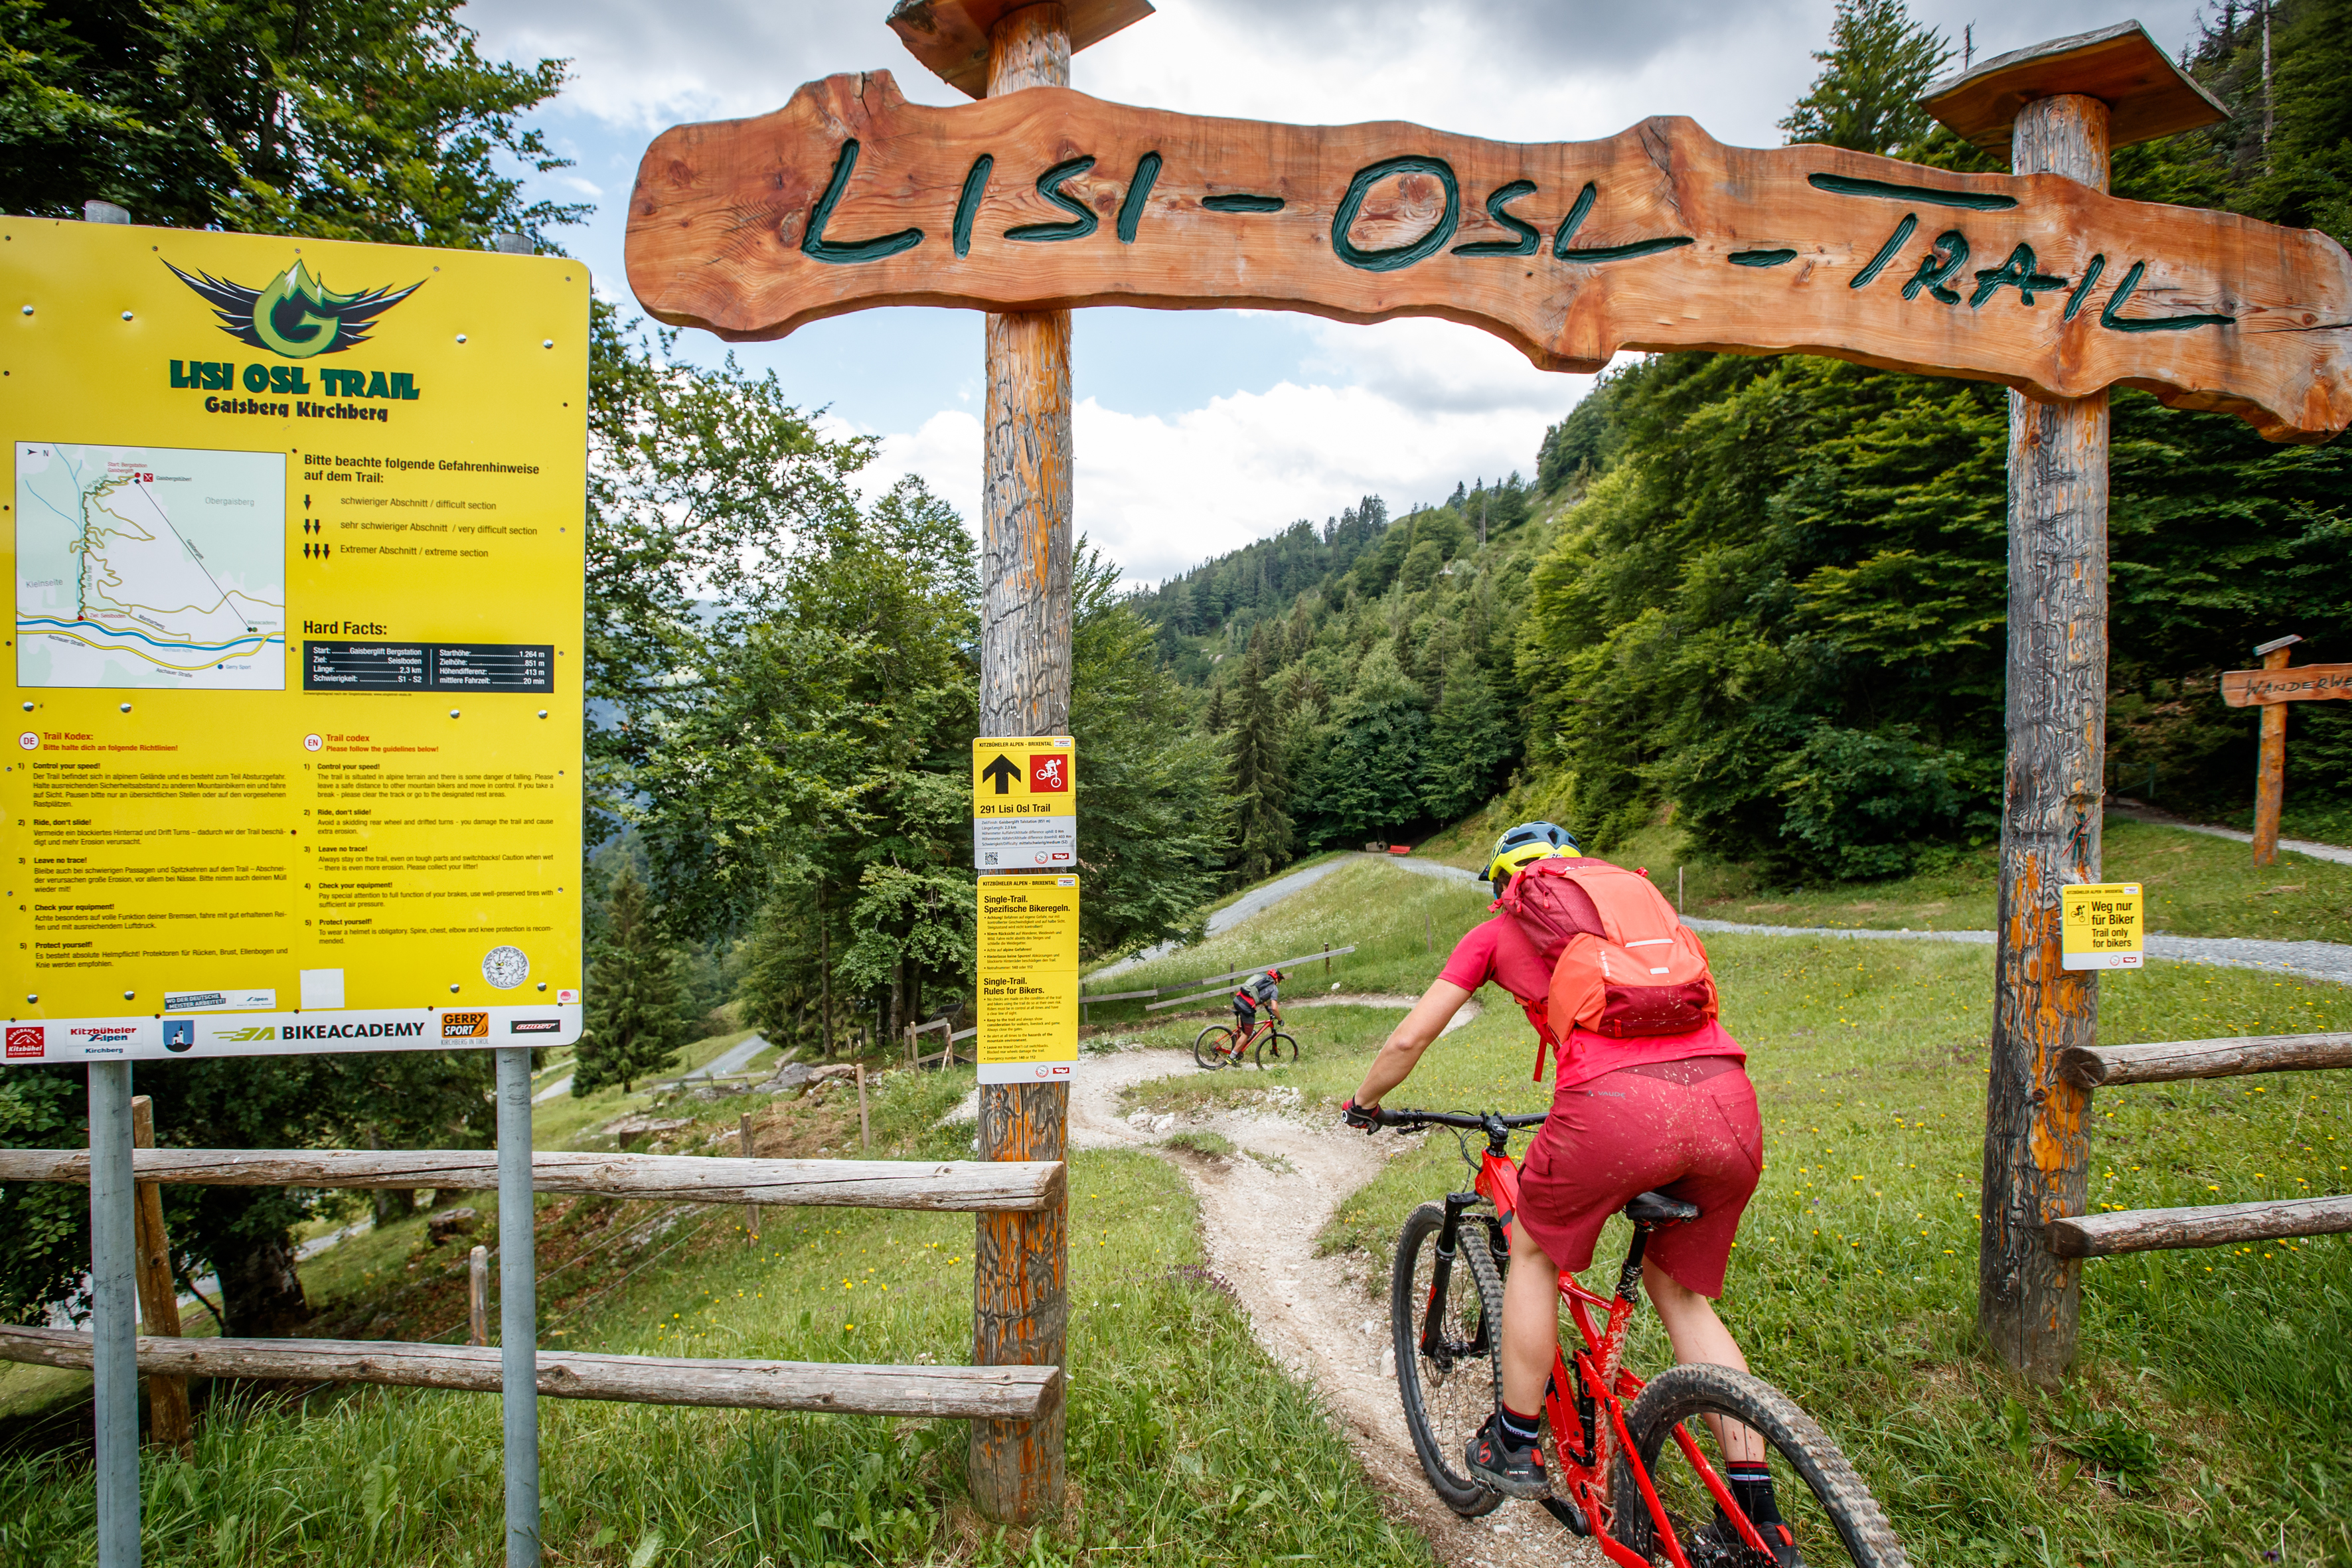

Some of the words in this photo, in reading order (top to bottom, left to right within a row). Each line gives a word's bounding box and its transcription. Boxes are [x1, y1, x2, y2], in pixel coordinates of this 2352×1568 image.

[169, 359, 235, 391] LISI
[243, 363, 311, 395] OSL
[320, 368, 421, 400] TRAIL
[204, 396, 289, 418] Gaisberg
[297, 401, 388, 422] Kirchberg
[304, 453, 331, 465] Bitte
[335, 455, 382, 467] beachte
[385, 457, 434, 471] folgende
[438, 459, 539, 474] Gefahrenhinweise
[304, 470, 323, 481] auf
[327, 471, 351, 481] dem
[355, 471, 383, 483] Trail:
[205, 497, 255, 507] Obergaisberg
[341, 497, 388, 507] schwieriger
[390, 498, 428, 507] Abschnitt
[435, 499, 465, 509] difficult
[340, 520, 358, 529] sehr
[360, 521, 408, 532] schwieriger
[409, 522, 447, 532] Abschnitt
[457, 526, 475, 534] very
[477, 525, 507, 534] difficult
[509, 526, 537, 535] section
[340, 544, 377, 554] Extremer
[378, 546, 417, 555] Abschnitt
[424, 548, 457, 556] extreme
[25, 578, 63, 588] Kleinseite
[303, 620, 338, 634] Hard
[343, 621, 386, 635] Facts:
[48, 634, 70, 643] Aschauer
[70, 639, 86, 648] Straße
[349, 647, 385, 656] Gaisberglift
[386, 647, 422, 657] Bergstation
[439, 649, 471, 657] Starthöhe:
[313, 665, 335, 674] Länge:
[399, 666, 410, 674] 2,3
[313, 674, 358, 683] Schwierigkeit:
[64, 732, 93, 741] Kodex:
[980, 805, 994, 813] 291
[998, 804, 1013, 813] Lisi
[1016, 804, 1029, 813] Osl
[1032, 803, 1050, 812] Trail
[984, 894, 1028, 905] Single-Trail.
[984, 904, 1027, 914] Spezifische
[1029, 903, 1070, 913] Bikeregeln.
[2091, 901, 2112, 913] Weg
[2092, 914, 2106, 925] für
[2109, 914, 2134, 924] Biker
[2092, 928, 2108, 937] Trail
[2112, 927, 2128, 938] only
[2092, 939, 2104, 947] for
[2106, 939, 2131, 948] bikers
[983, 977, 1027, 986] Single-Trail.
[190, 993, 220, 1002] DEUTSCHE
[195, 998, 225, 1007] ARBEITET!
[443, 1013, 487, 1025] GERRY
[8, 1028, 36, 1041] BERGBAHN
[35, 1032, 42, 1040] AG
[70, 1027, 137, 1036] Kitzbüheler
[282, 1022, 425, 1040] BIKEACADEMY
[444, 1025, 474, 1036] SPORT
[88, 1034, 128, 1042] Alpen
